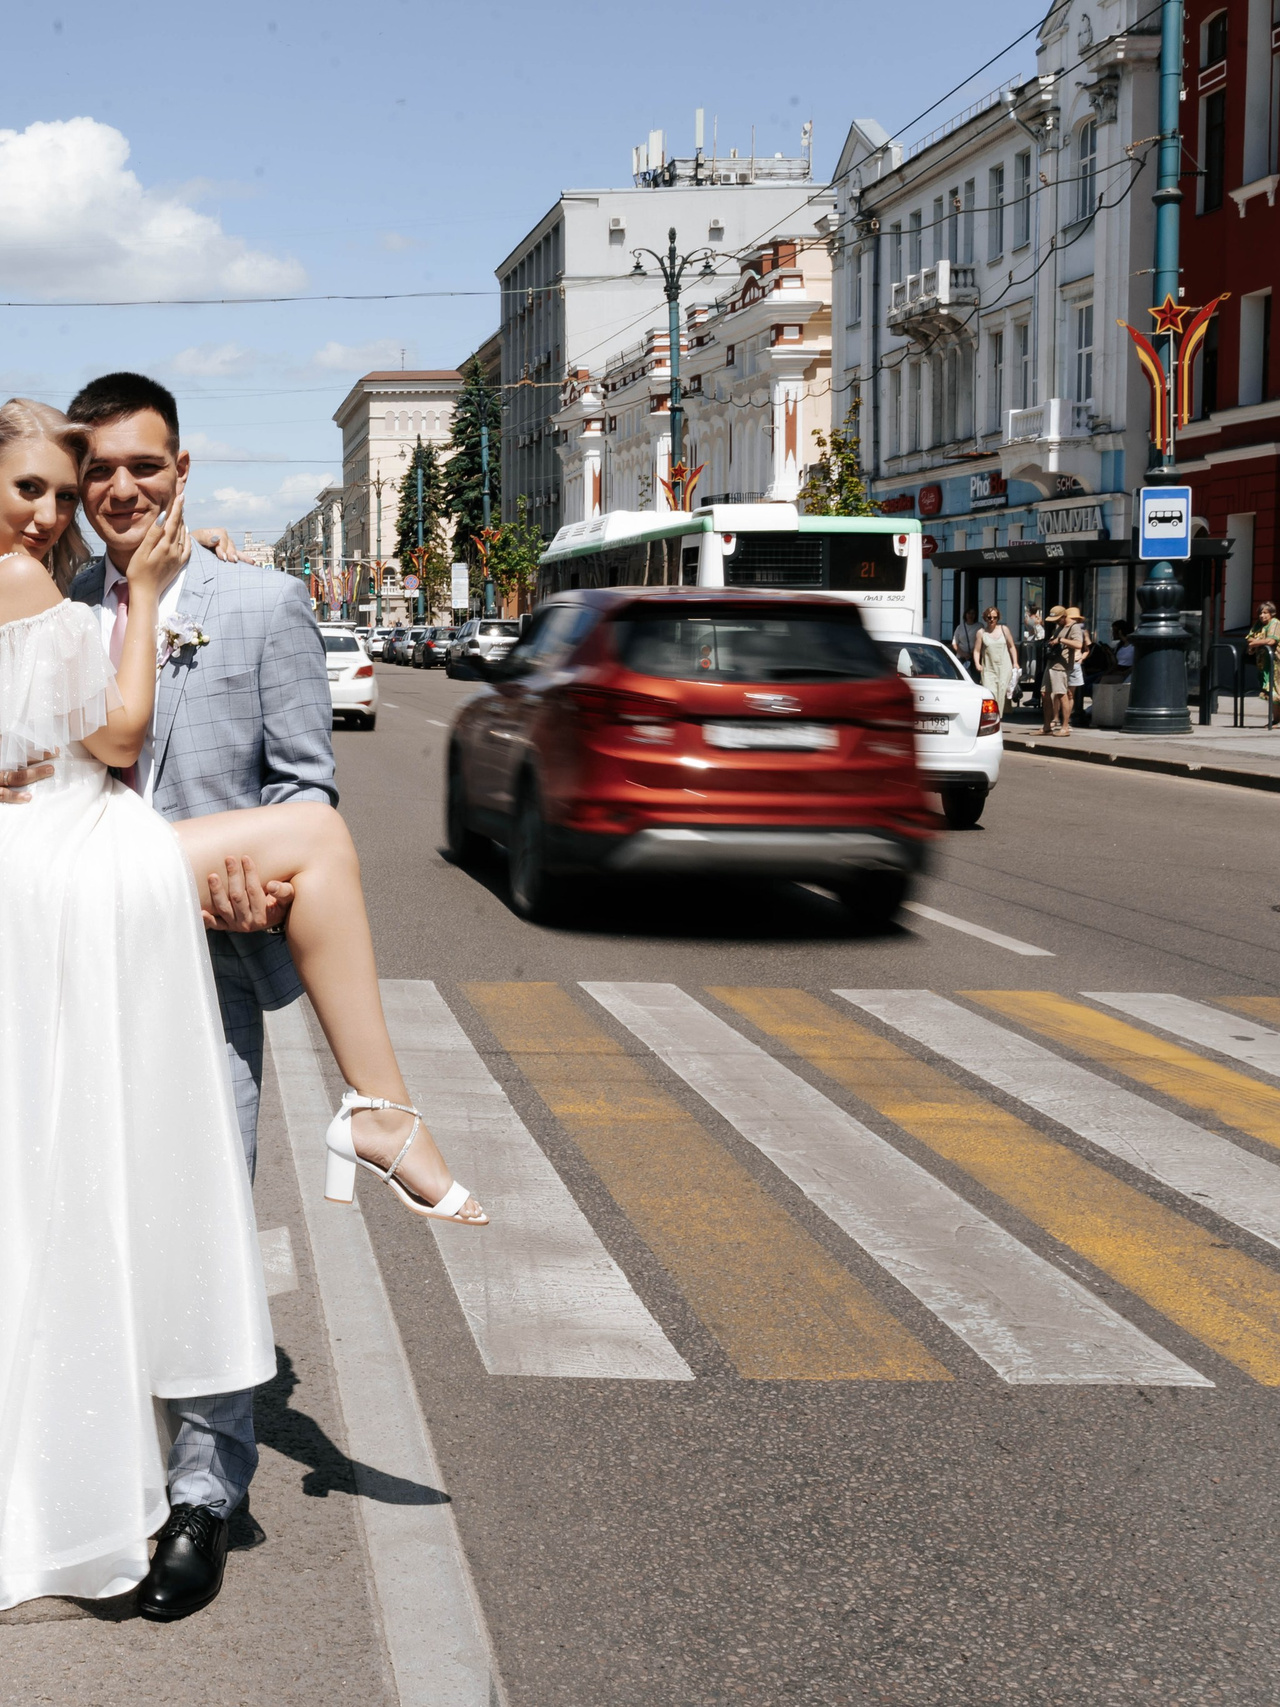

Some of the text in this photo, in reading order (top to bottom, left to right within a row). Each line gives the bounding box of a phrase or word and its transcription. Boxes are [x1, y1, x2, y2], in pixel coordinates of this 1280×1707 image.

[1037, 506, 1103, 535] КОММУНА
[860, 561, 875, 578] 21
[929, 717, 946, 726] 198
